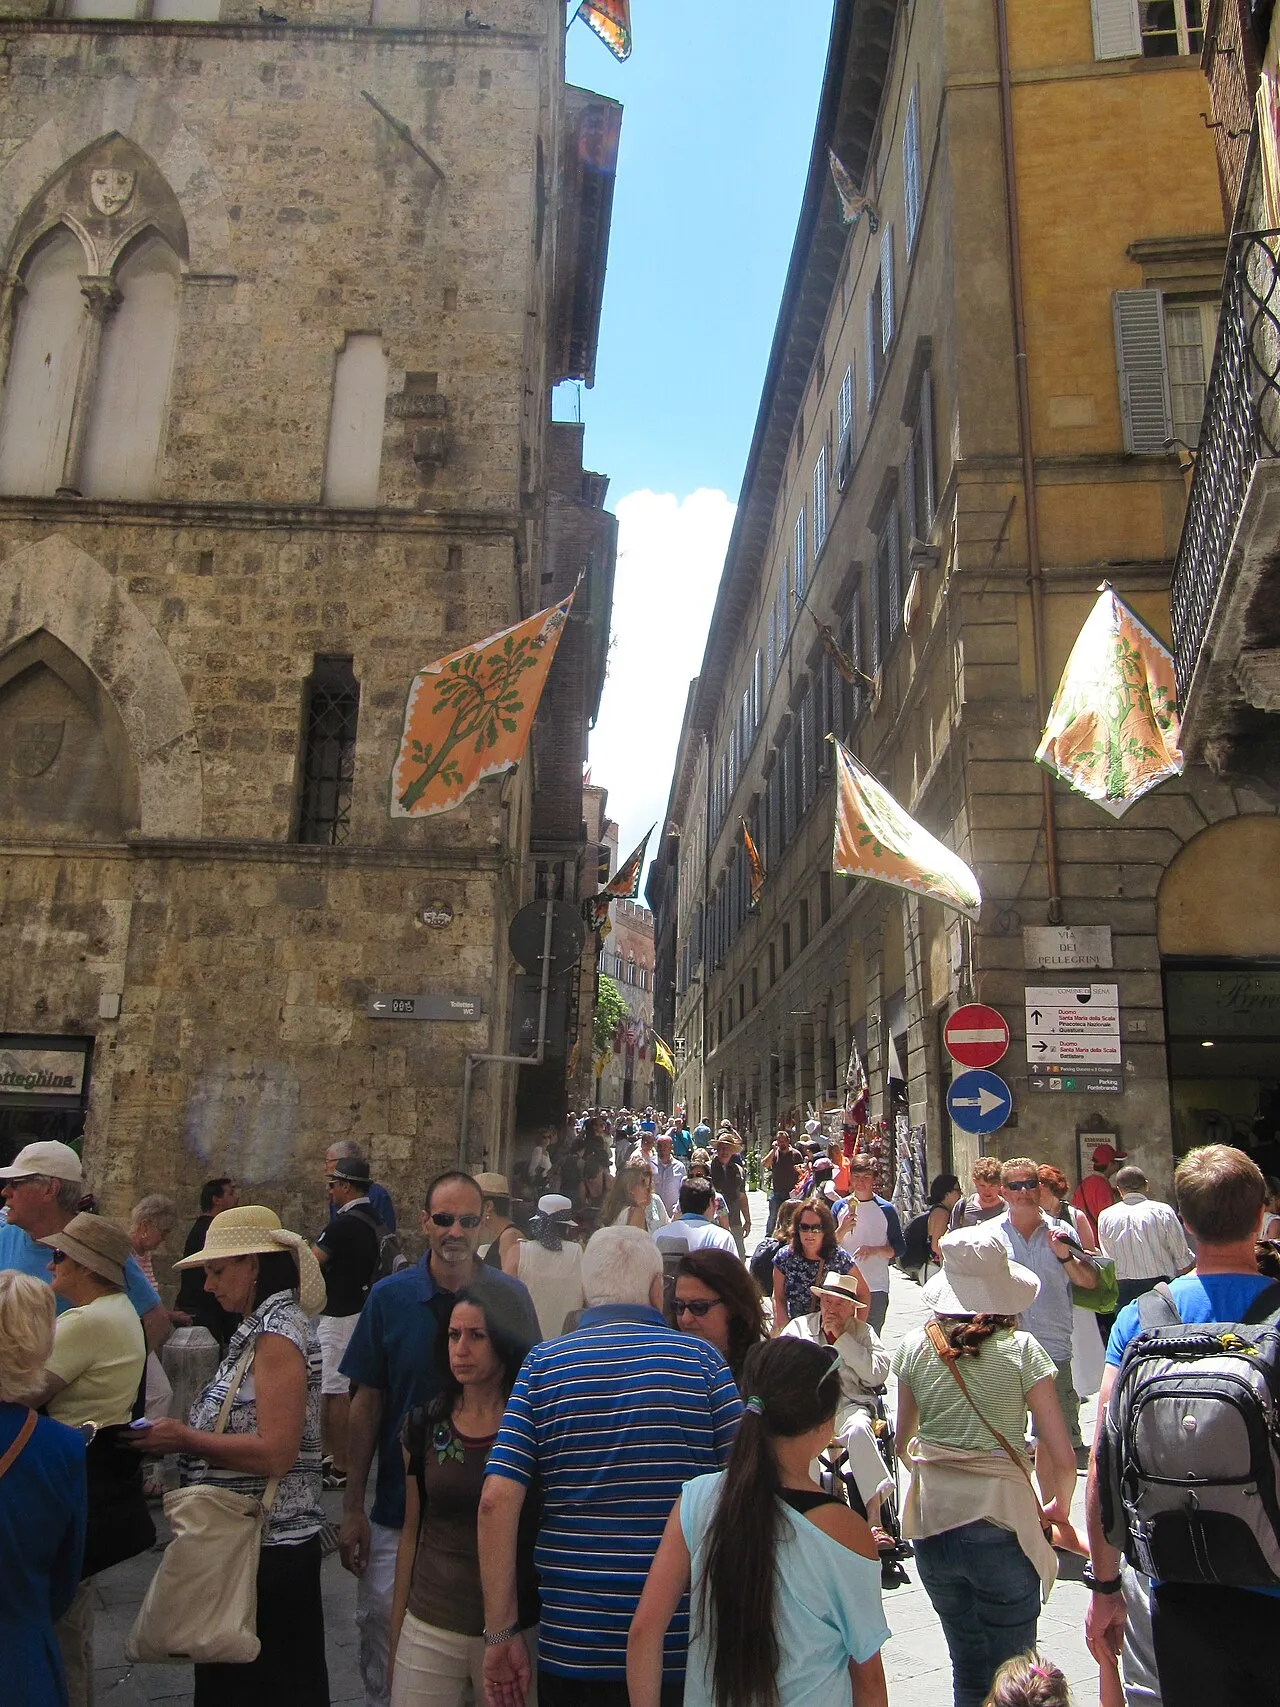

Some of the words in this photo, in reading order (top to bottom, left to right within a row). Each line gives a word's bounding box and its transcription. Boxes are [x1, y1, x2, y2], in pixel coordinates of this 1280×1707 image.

[1058, 931, 1076, 940] VIA
[1059, 943, 1077, 952] DEI
[1038, 955, 1100, 965] PELLEGRINI
